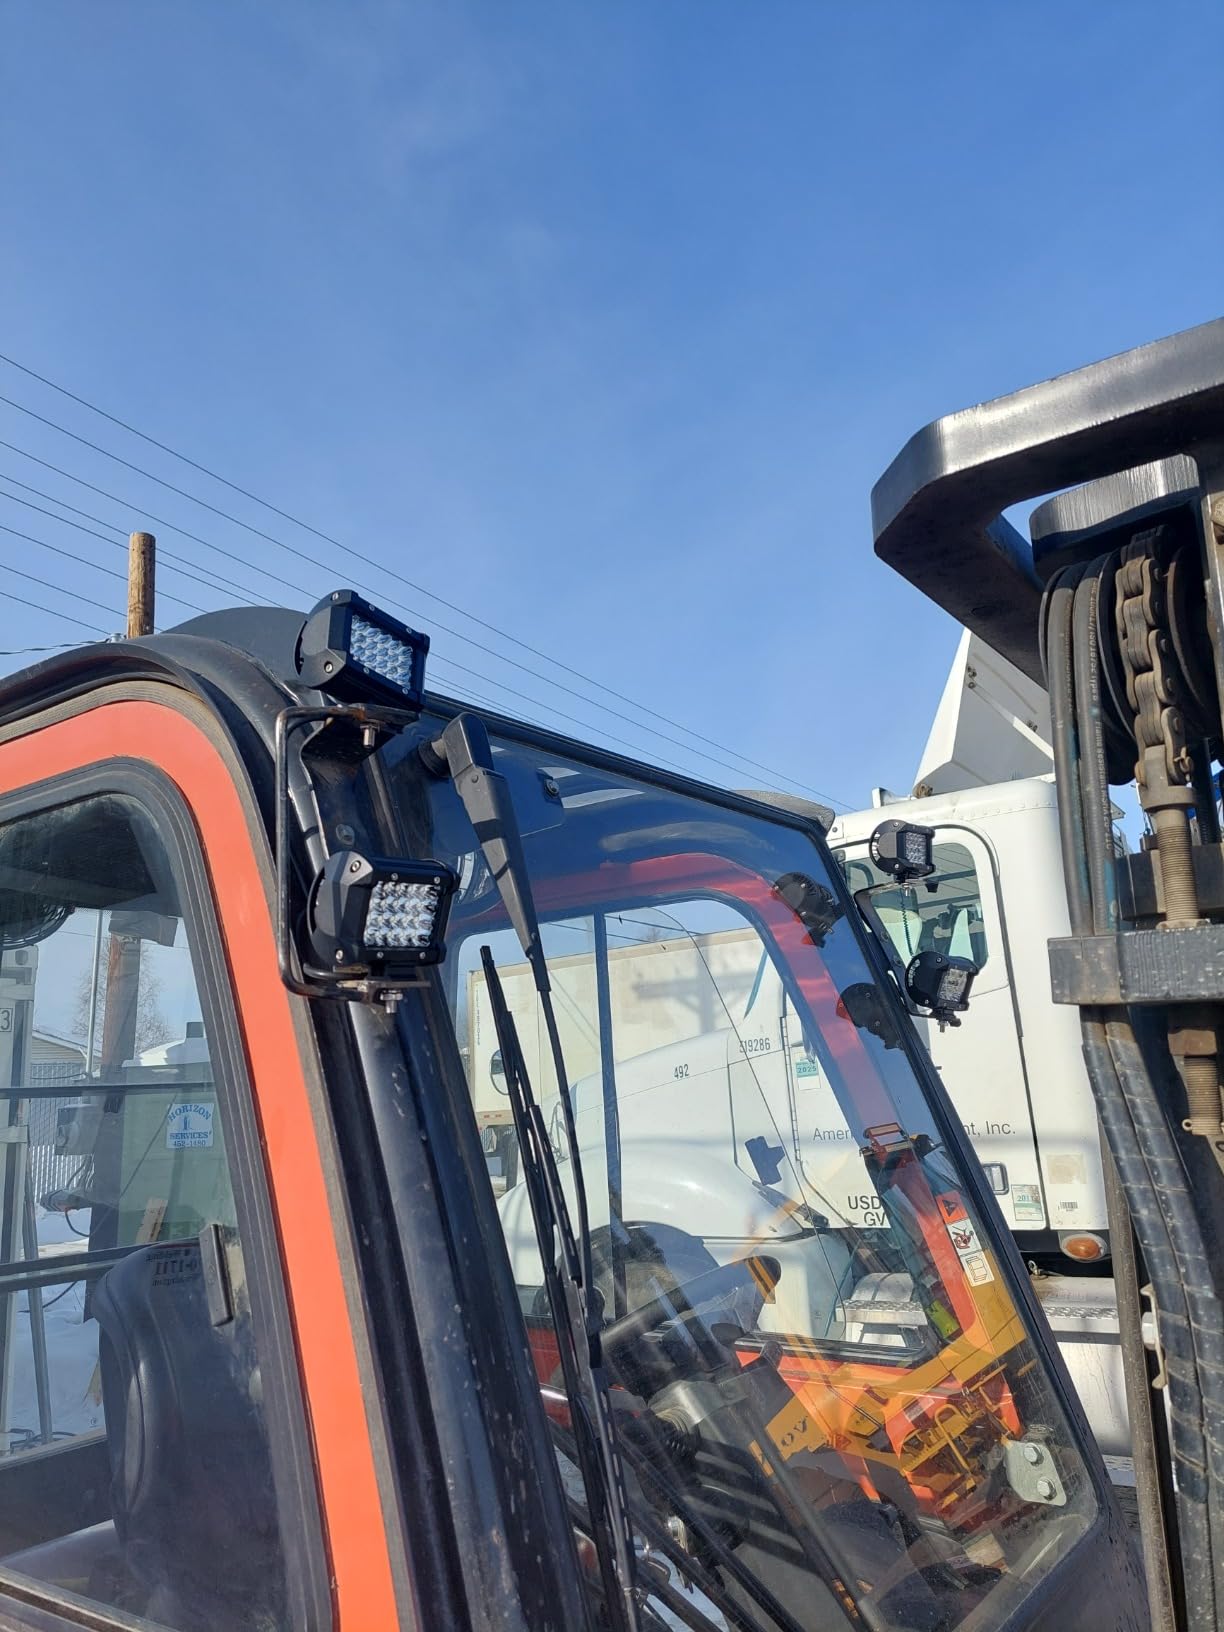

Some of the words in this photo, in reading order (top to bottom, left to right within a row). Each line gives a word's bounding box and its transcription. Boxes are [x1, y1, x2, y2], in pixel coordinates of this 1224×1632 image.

[673, 1063, 690, 1080] 492
[796, 1065, 817, 1074] 2025
[168, 1104, 211, 1121] HORIZON
[985, 1120, 1016, 1135] Inc.
[169, 1131, 209, 1140] SERVICES
